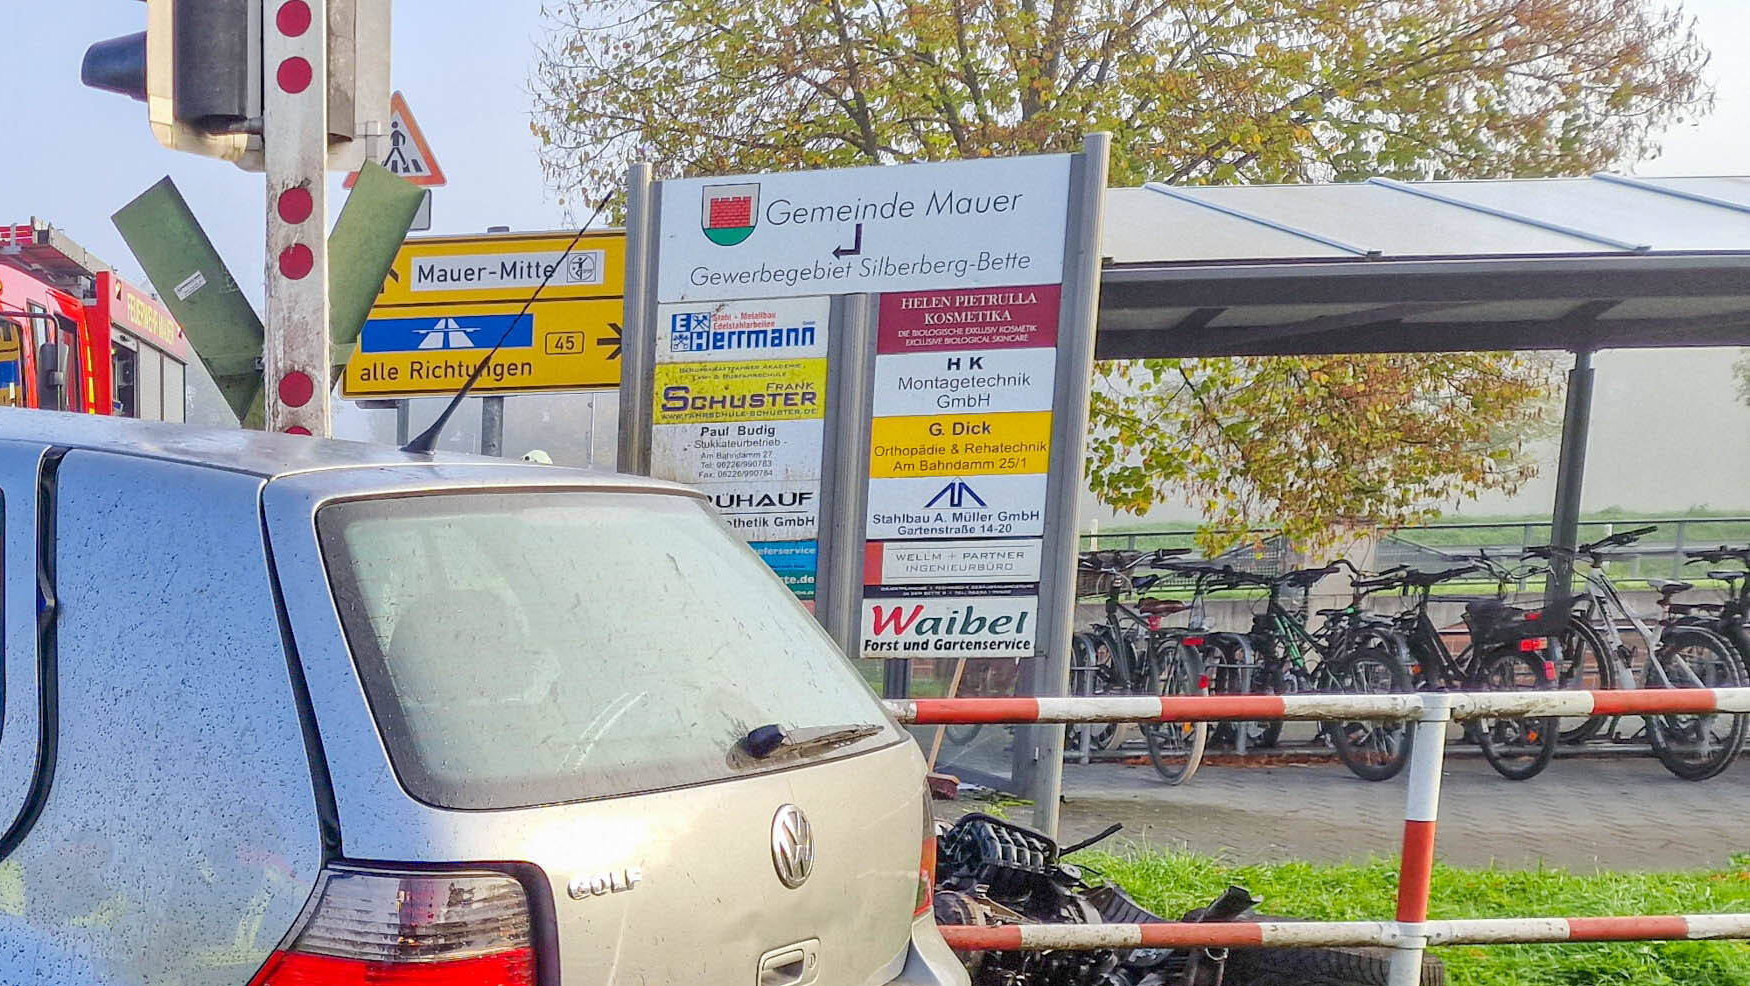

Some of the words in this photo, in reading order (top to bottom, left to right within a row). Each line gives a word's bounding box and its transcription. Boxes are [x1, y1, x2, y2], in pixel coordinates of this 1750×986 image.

[766, 191, 914, 225] Gemeinde
[925, 190, 1023, 217] Mauer
[417, 260, 556, 283] Mauer-Mitte
[690, 260, 852, 287] Gewerbegebiet
[858, 250, 1031, 279] Silberberg-Bette
[901, 296, 952, 309] HELEN
[955, 292, 1037, 307] PIETRULLA
[924, 310, 1012, 325] KOSMETIKA
[898, 330, 911, 338] DIE
[912, 327, 964, 337] BIOLOGISCHE
[999, 324, 1037, 334] KOSMETIK
[555, 335, 576, 351] 45
[944, 336, 991, 345] BIOLOGICAL
[947, 357, 961, 371] H
[970, 356, 985, 370] K
[360, 362, 399, 382] alle
[766, 381, 815, 391] FRANK
[898, 372, 1031, 393] Montagetechnik
[661, 385, 818, 412] SCHUSTER
[937, 393, 991, 409] GmbH
[700, 426, 730, 437] Paul
[738, 425, 776, 437] Budig
[929, 422, 945, 436] G.
[952, 421, 992, 436] Dick
[693, 438, 781, 449] Stukkateurbetrieb
[874, 444, 946, 458] Orthopädie
[950, 443, 959, 455] &
[964, 441, 1048, 455] Rehatechnik
[716, 451, 761, 460] Bahndamm
[893, 460, 915, 472] Am
[919, 459, 995, 472] Bahndamm
[999, 457, 1027, 470] 25/1
[707, 491, 814, 508] ÜHAUF
[727, 516, 769, 529] thetik
[774, 515, 815, 527] GmbH
[873, 513, 930, 525] Stahlbau
[934, 512, 947, 523] A.
[952, 511, 994, 523] Müller
[997, 510, 1040, 522] GmbH
[897, 525, 976, 536] Gartenstraße
[980, 523, 1013, 534] 14-20
[896, 553, 942, 561] WELLM
[963, 551, 1025, 560] PARTNER
[872, 604, 1029, 636] Waibel
[864, 638, 899, 651] Forst
[903, 638, 930, 651] und
[933, 637, 1031, 651] Gartenservice
[567, 866, 643, 900] GOLF
